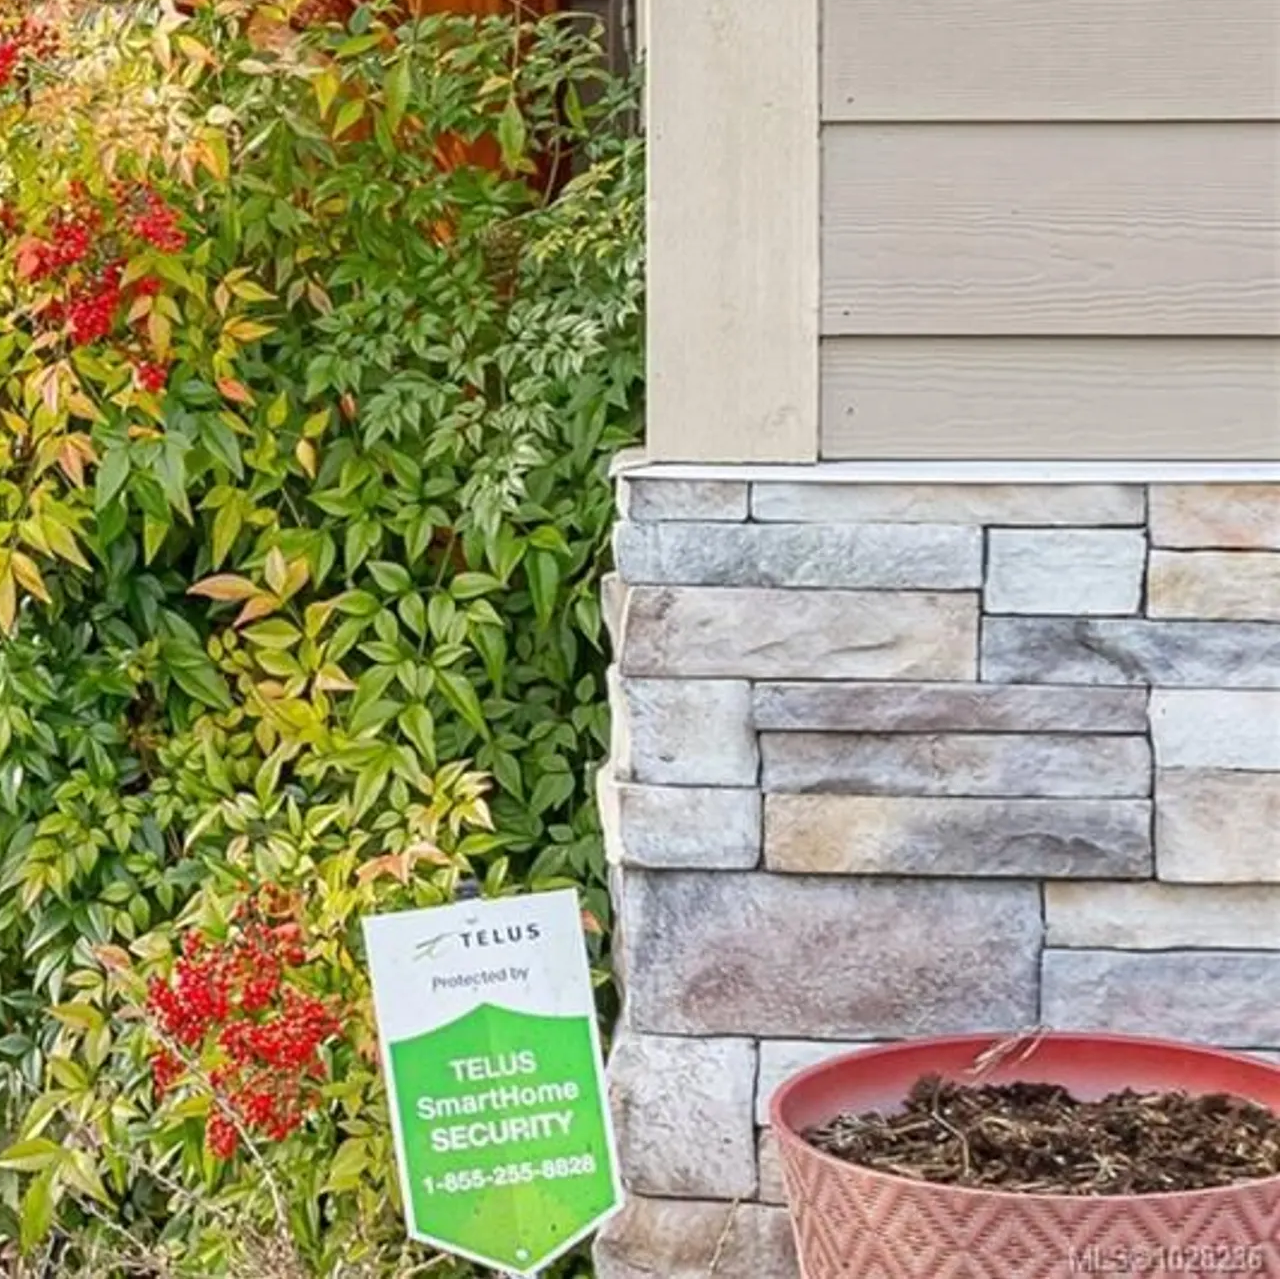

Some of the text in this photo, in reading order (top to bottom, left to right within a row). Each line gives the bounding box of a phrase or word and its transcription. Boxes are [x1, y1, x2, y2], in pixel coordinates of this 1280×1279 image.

[459, 922, 540, 949] TELUS
[431, 966, 530, 992] Protected by
[448, 1050, 537, 1082] TELUS
[416, 1081, 579, 1120] SmartHome
[431, 1110, 574, 1152] SECURITY
